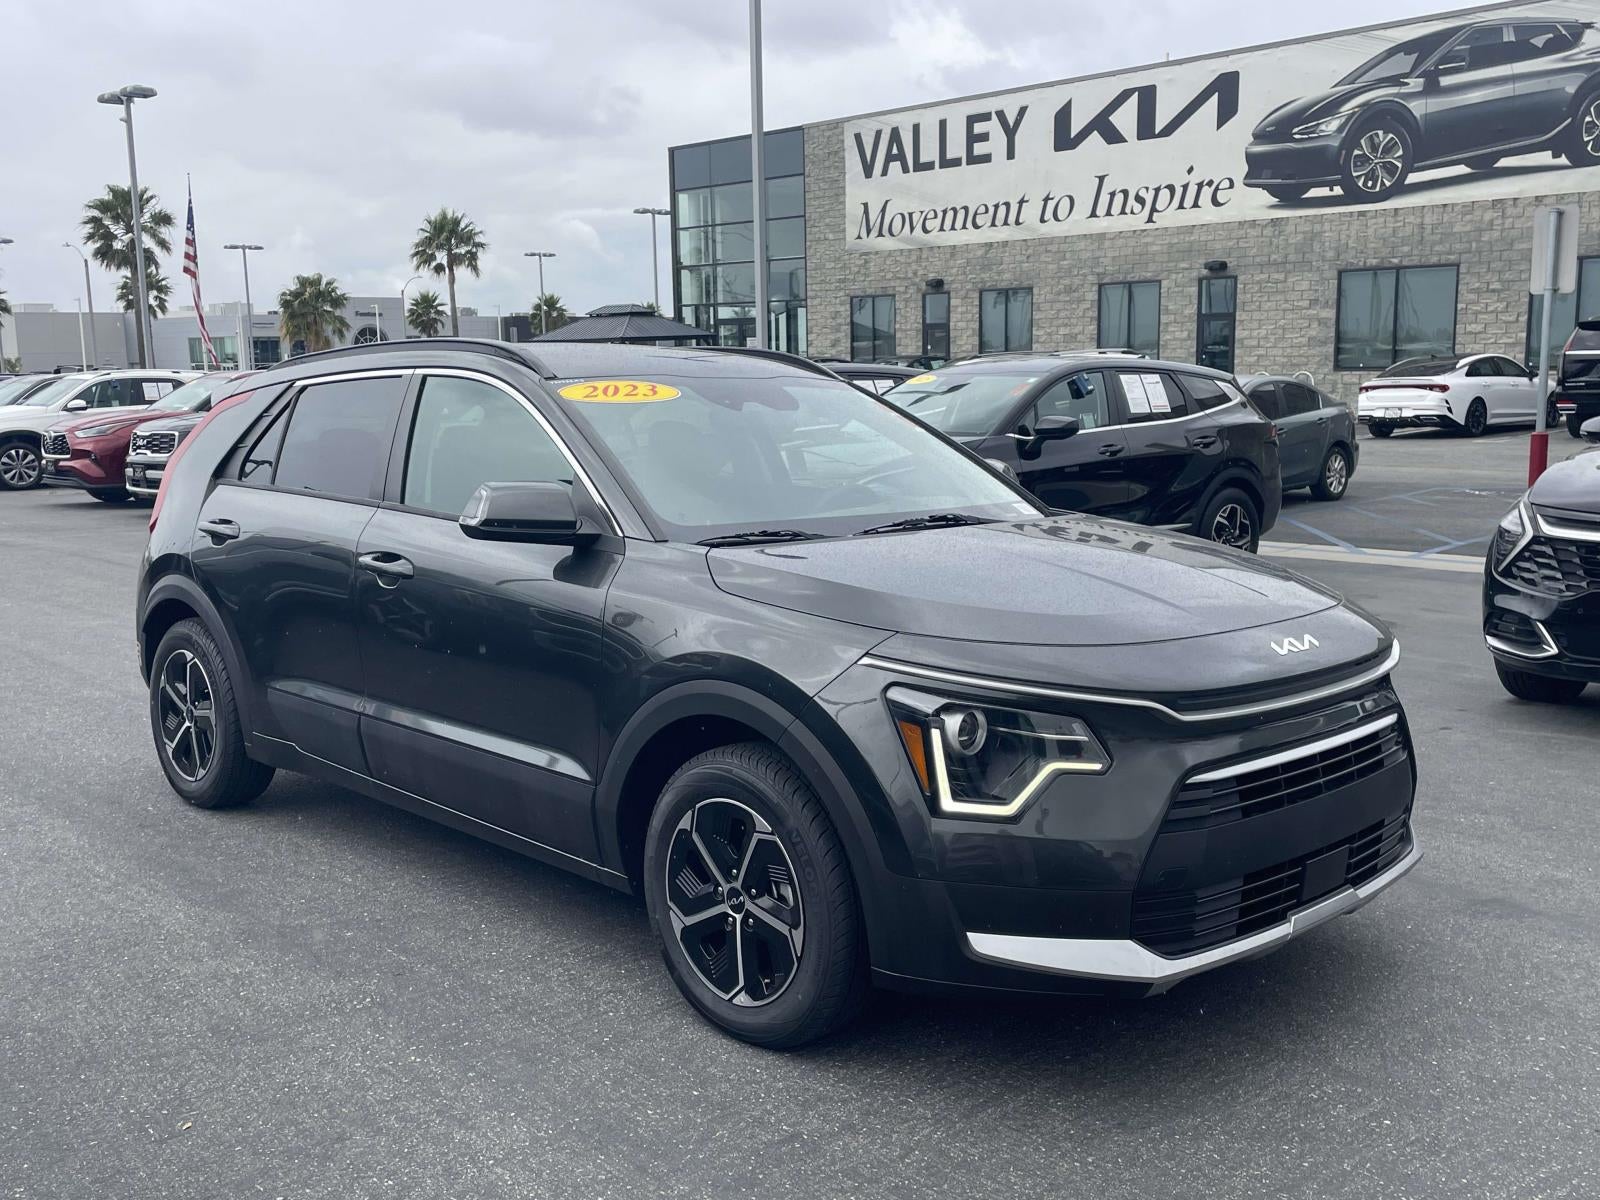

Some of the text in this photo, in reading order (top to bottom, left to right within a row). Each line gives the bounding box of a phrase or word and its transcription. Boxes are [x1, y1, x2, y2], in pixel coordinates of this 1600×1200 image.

[853, 70, 1240, 181] VALLEY KIA
[854, 165, 1236, 241] Movement to Inspire
[583, 384, 658, 398] 2023
[1270, 633, 1320, 656] KIA
